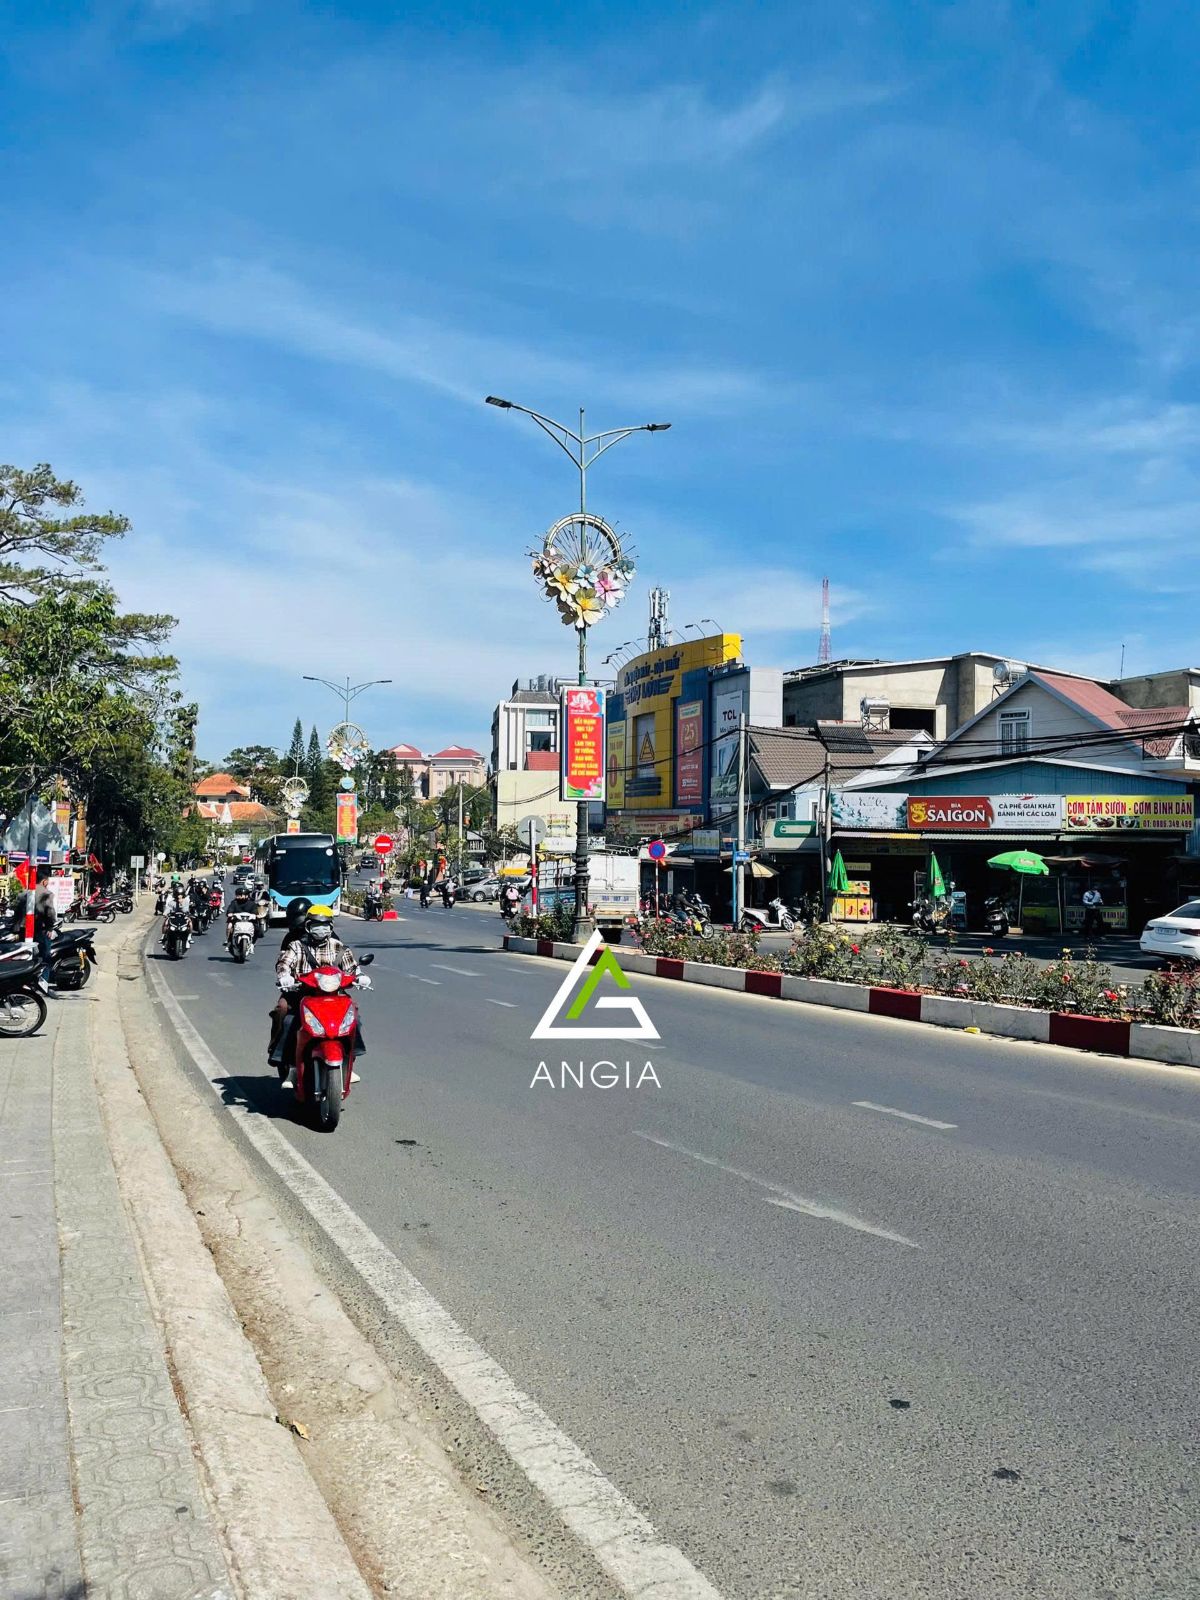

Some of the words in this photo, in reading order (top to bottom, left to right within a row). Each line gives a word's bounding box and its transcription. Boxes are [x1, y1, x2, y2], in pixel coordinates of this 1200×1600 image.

[722, 708, 737, 721] TCL
[1067, 801, 1084, 815] CƠM
[1133, 801, 1151, 815] CƠM
[1154, 799, 1173, 815] BÌNH
[927, 809, 986, 823] SAIGON
